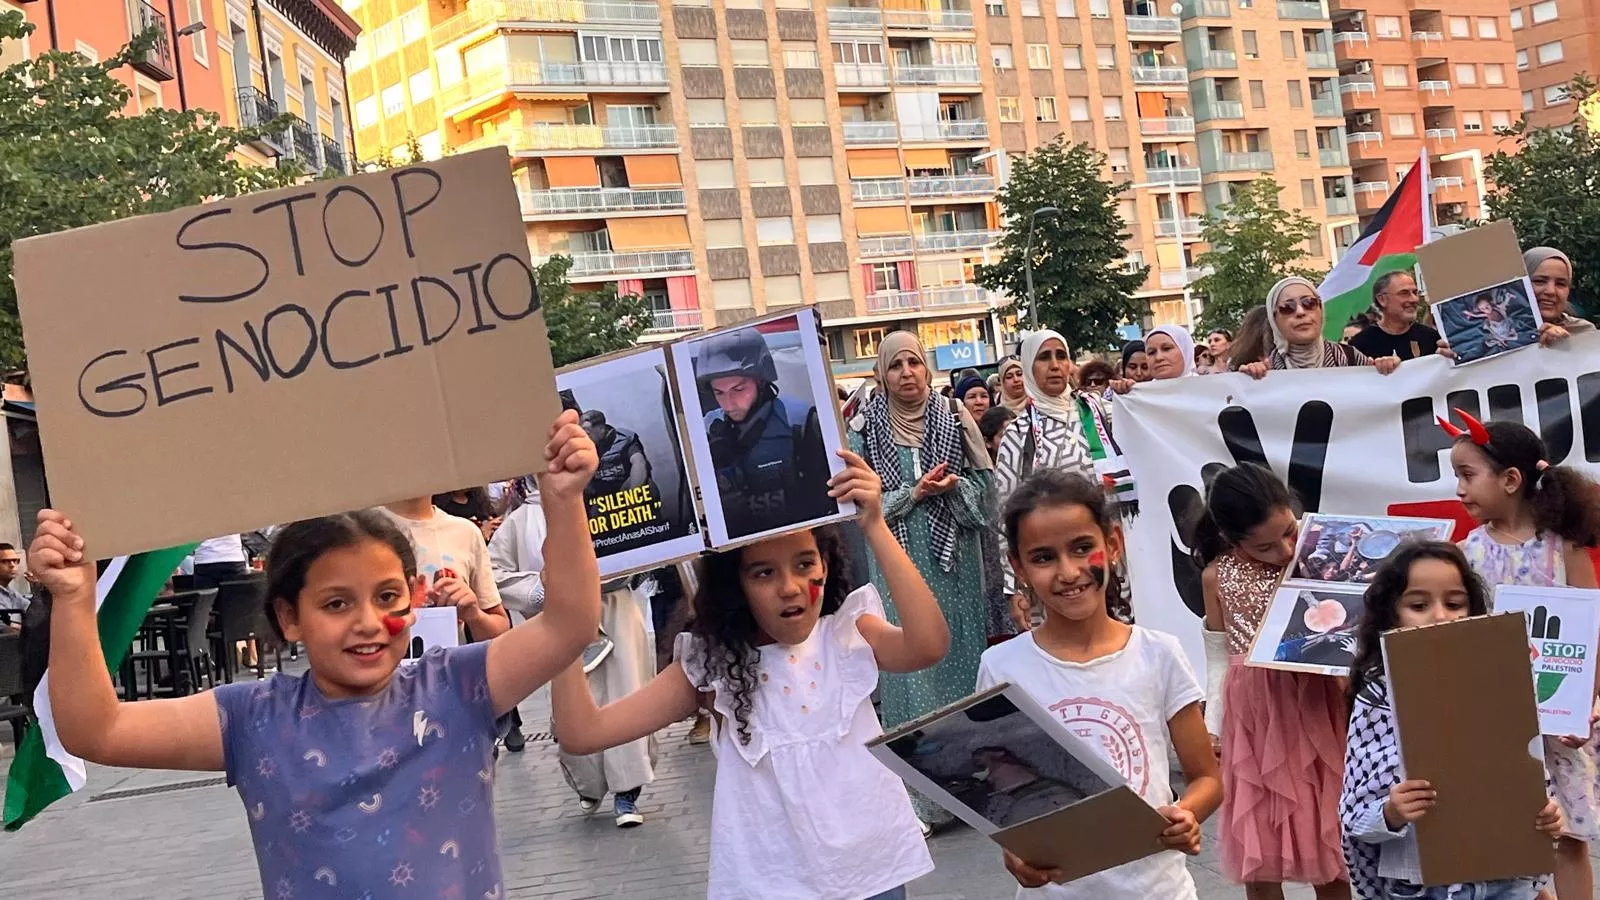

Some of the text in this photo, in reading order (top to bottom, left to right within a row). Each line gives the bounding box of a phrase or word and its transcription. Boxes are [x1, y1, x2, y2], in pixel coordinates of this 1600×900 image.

[176, 167, 442, 303] STOP
[78, 253, 542, 418] GENOCIDIO
[589, 485, 652, 513] “SILENCE
[588, 501, 662, 535] OR DEATH.”
[1543, 643, 1586, 658] STOP
[1544, 657, 1583, 665] GENOCIDIO
[1541, 664, 1582, 673] PALESTINO
[1100, 708, 1142, 757] GIRLS
